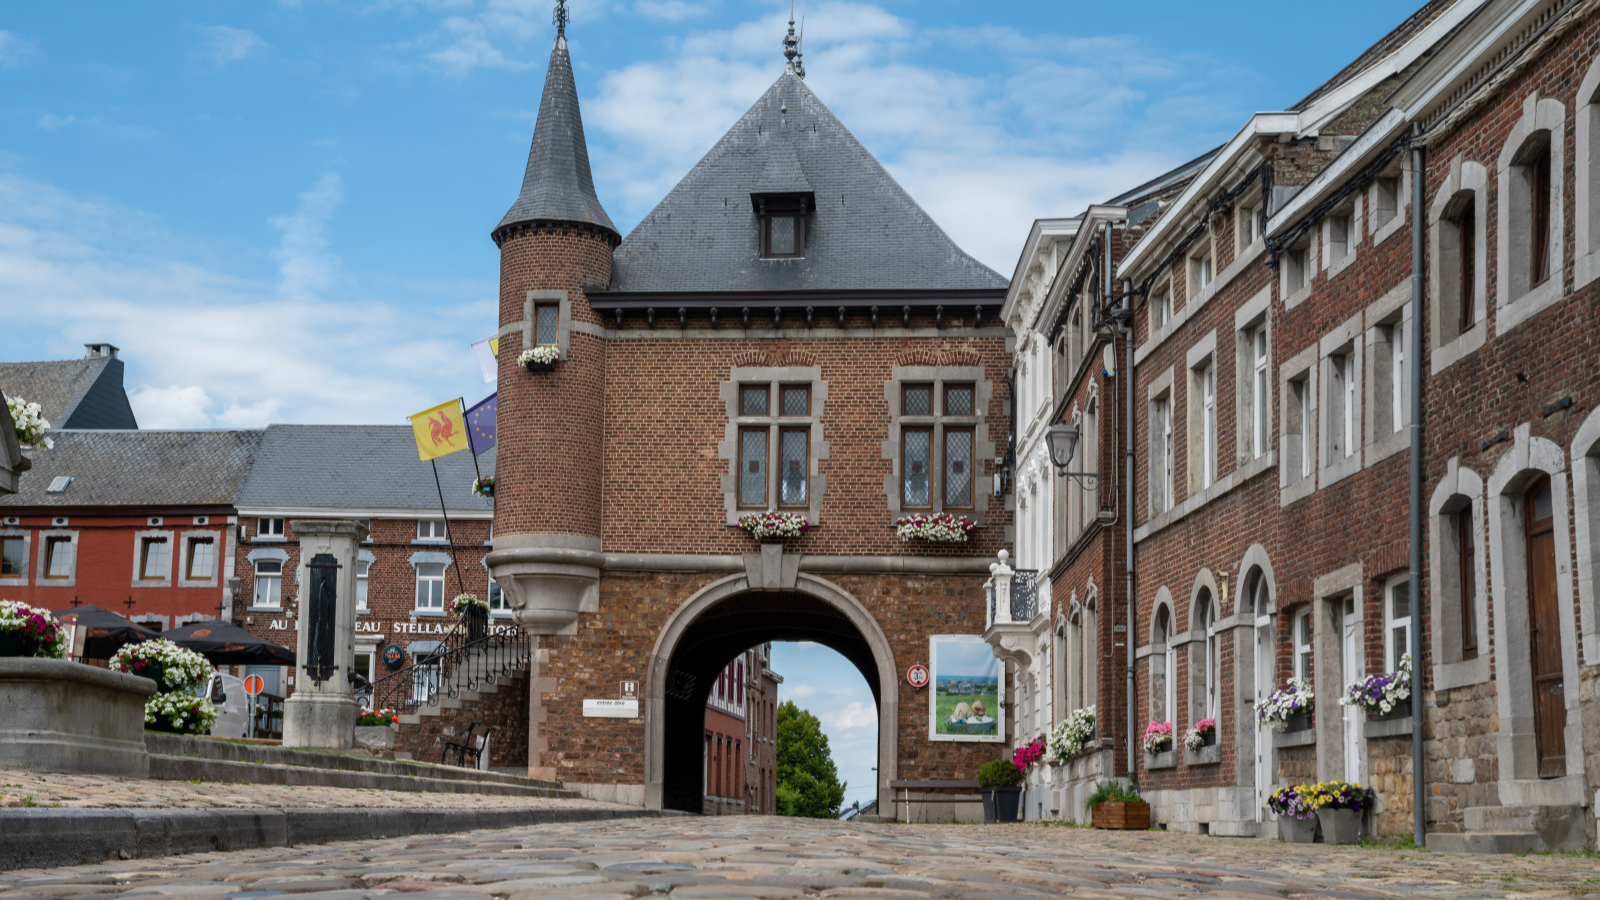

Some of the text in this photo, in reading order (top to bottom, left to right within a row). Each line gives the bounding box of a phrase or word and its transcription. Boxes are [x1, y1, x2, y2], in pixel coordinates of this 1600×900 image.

[269, 619, 288, 631] AU
[354, 621, 381, 632] EAU
[393, 622, 443, 634] STELLA
